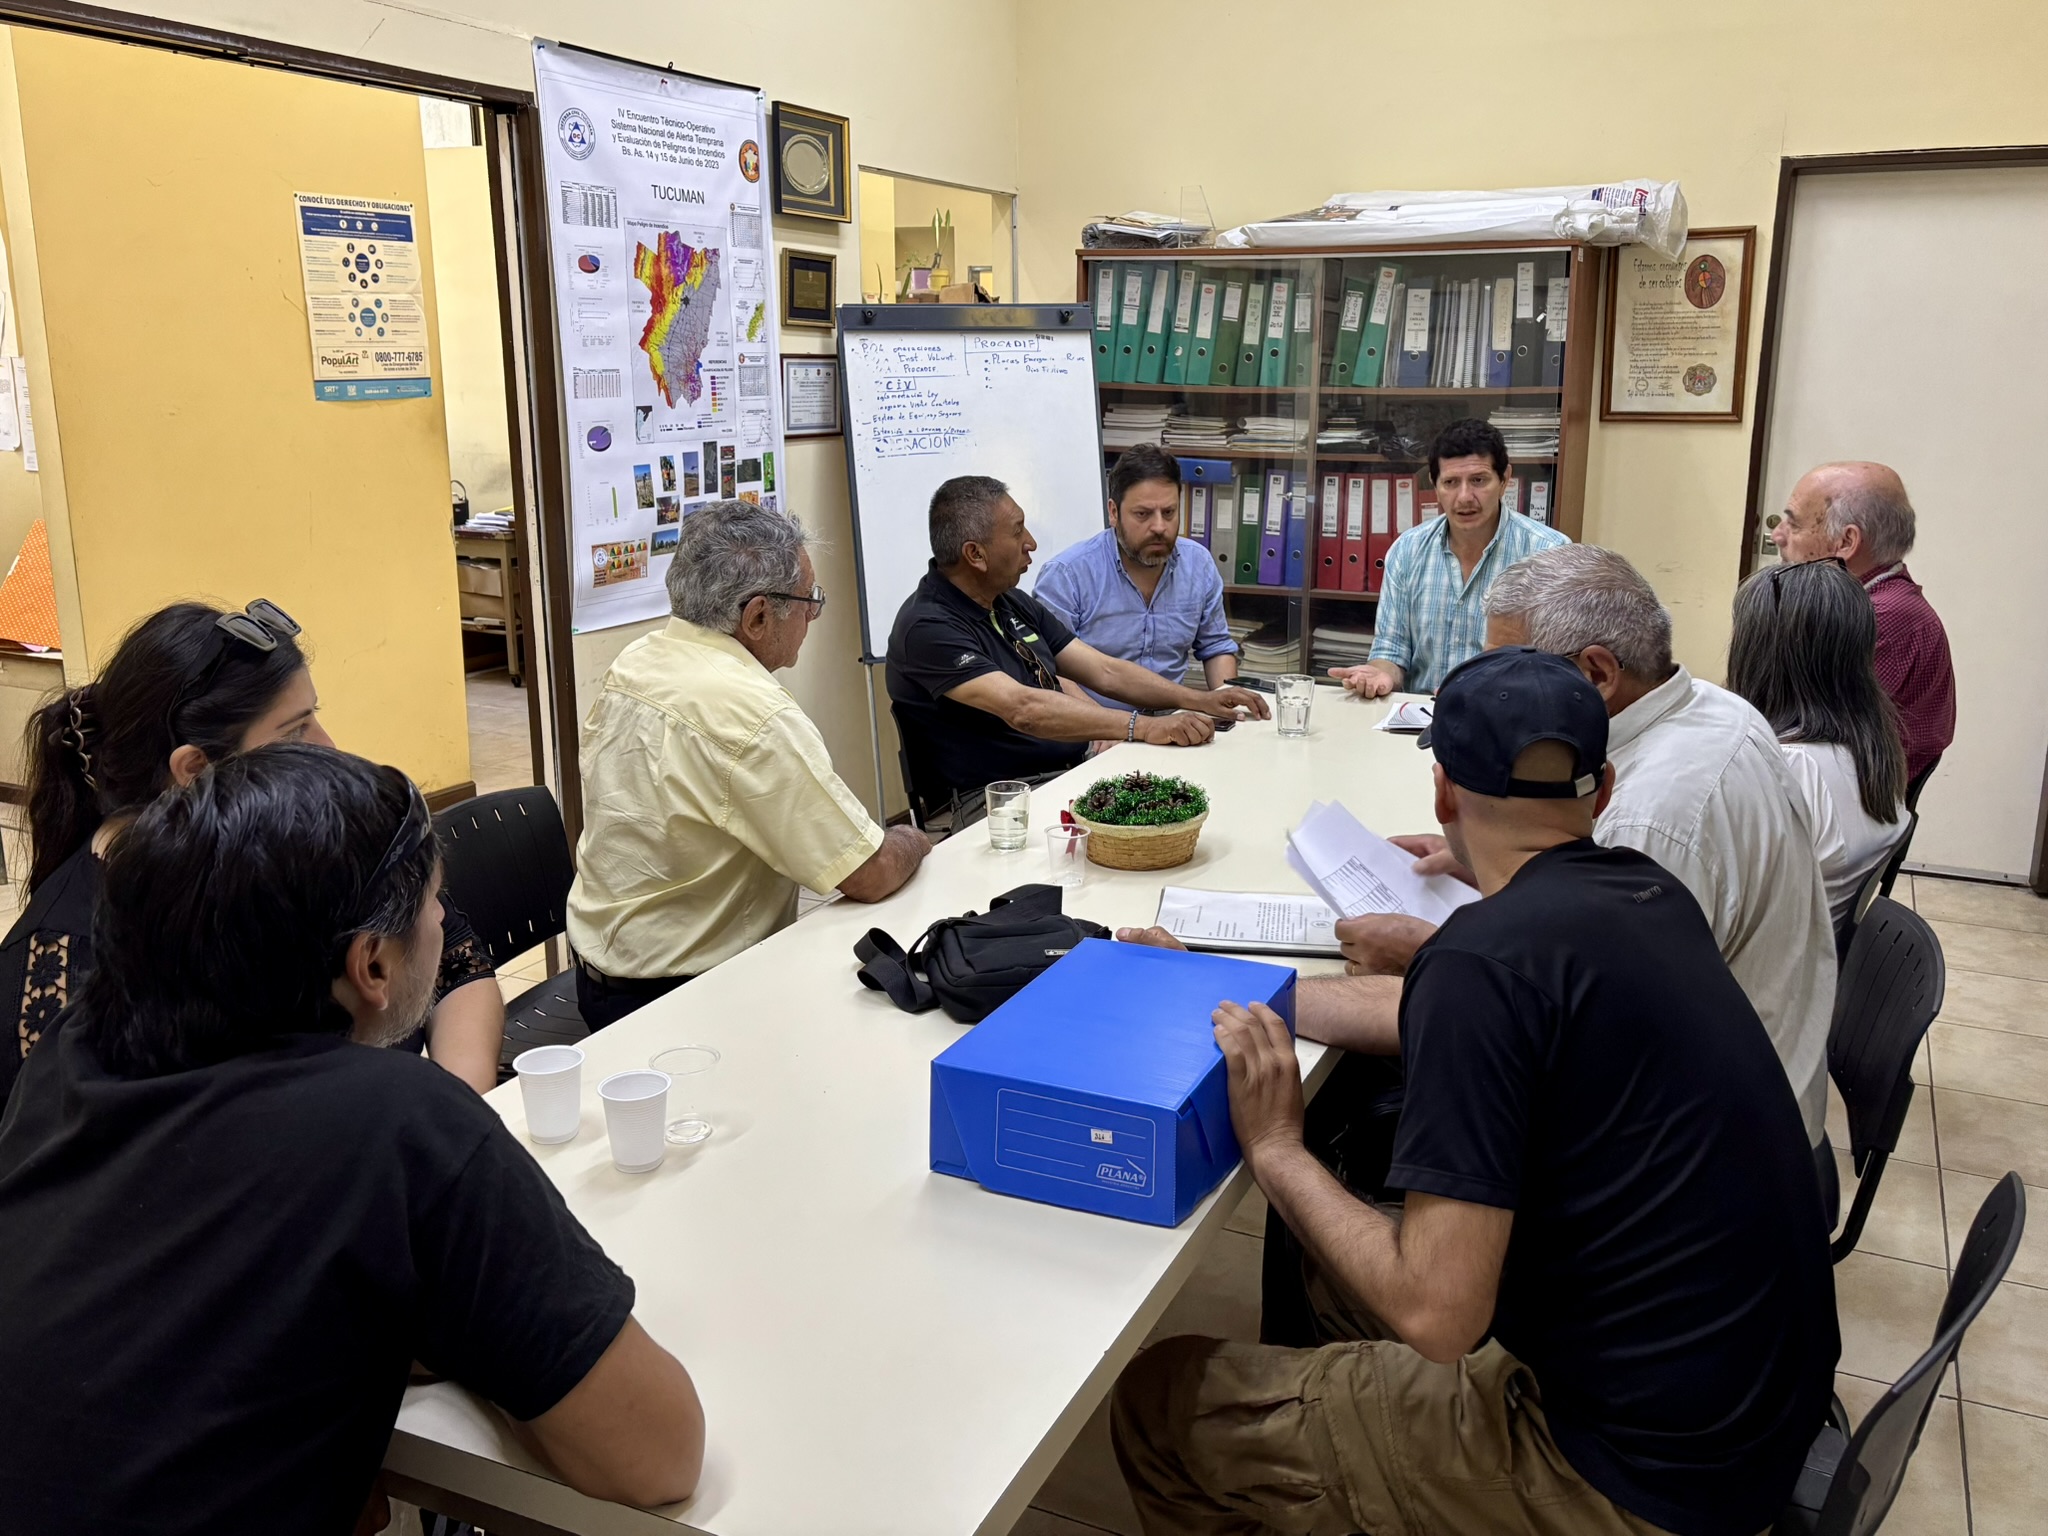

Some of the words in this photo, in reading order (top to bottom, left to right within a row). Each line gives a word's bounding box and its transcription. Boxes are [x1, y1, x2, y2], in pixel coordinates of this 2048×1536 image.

[618, 108, 625, 118] IV
[626, 110, 659, 125] Encuentro
[660, 116, 716, 134] Técnico-Operativo
[611, 119, 637, 133] Sistema
[638, 124, 665, 135] Nacional
[667, 129, 675, 139] de
[676, 131, 694, 142] Alerta
[694, 134, 724, 147] Temprana
[618, 133, 652, 147] Evaluación
[653, 139, 661, 149] de
[662, 141, 687, 154] Peligros
[688, 145, 696, 155] de
[697, 147, 725, 159] Incendios
[622, 146, 633, 156] Bs.
[634, 148, 644, 158] As.
[646, 150, 654, 159] 14
[660, 152, 668, 162] 15
[669, 154, 677, 163] de
[678, 156, 694, 166] Junio
[695, 158, 703, 167] de
[704, 159, 720, 169] 2023
[651, 184, 705, 204] TUCUMAN
[299, 195, 323, 204] CONOCÉ
[324, 197, 335, 205] TUS
[336, 198, 366, 208] DERECHOS
[372, 202, 410, 212] OBLIGACIONES
[974, 337, 1035, 349] PROCADIF
[321, 355, 359, 366] PopulArt
[375, 352, 422, 362] 0800-777-6785
[1100, 1167, 1138, 1182] PLANA
